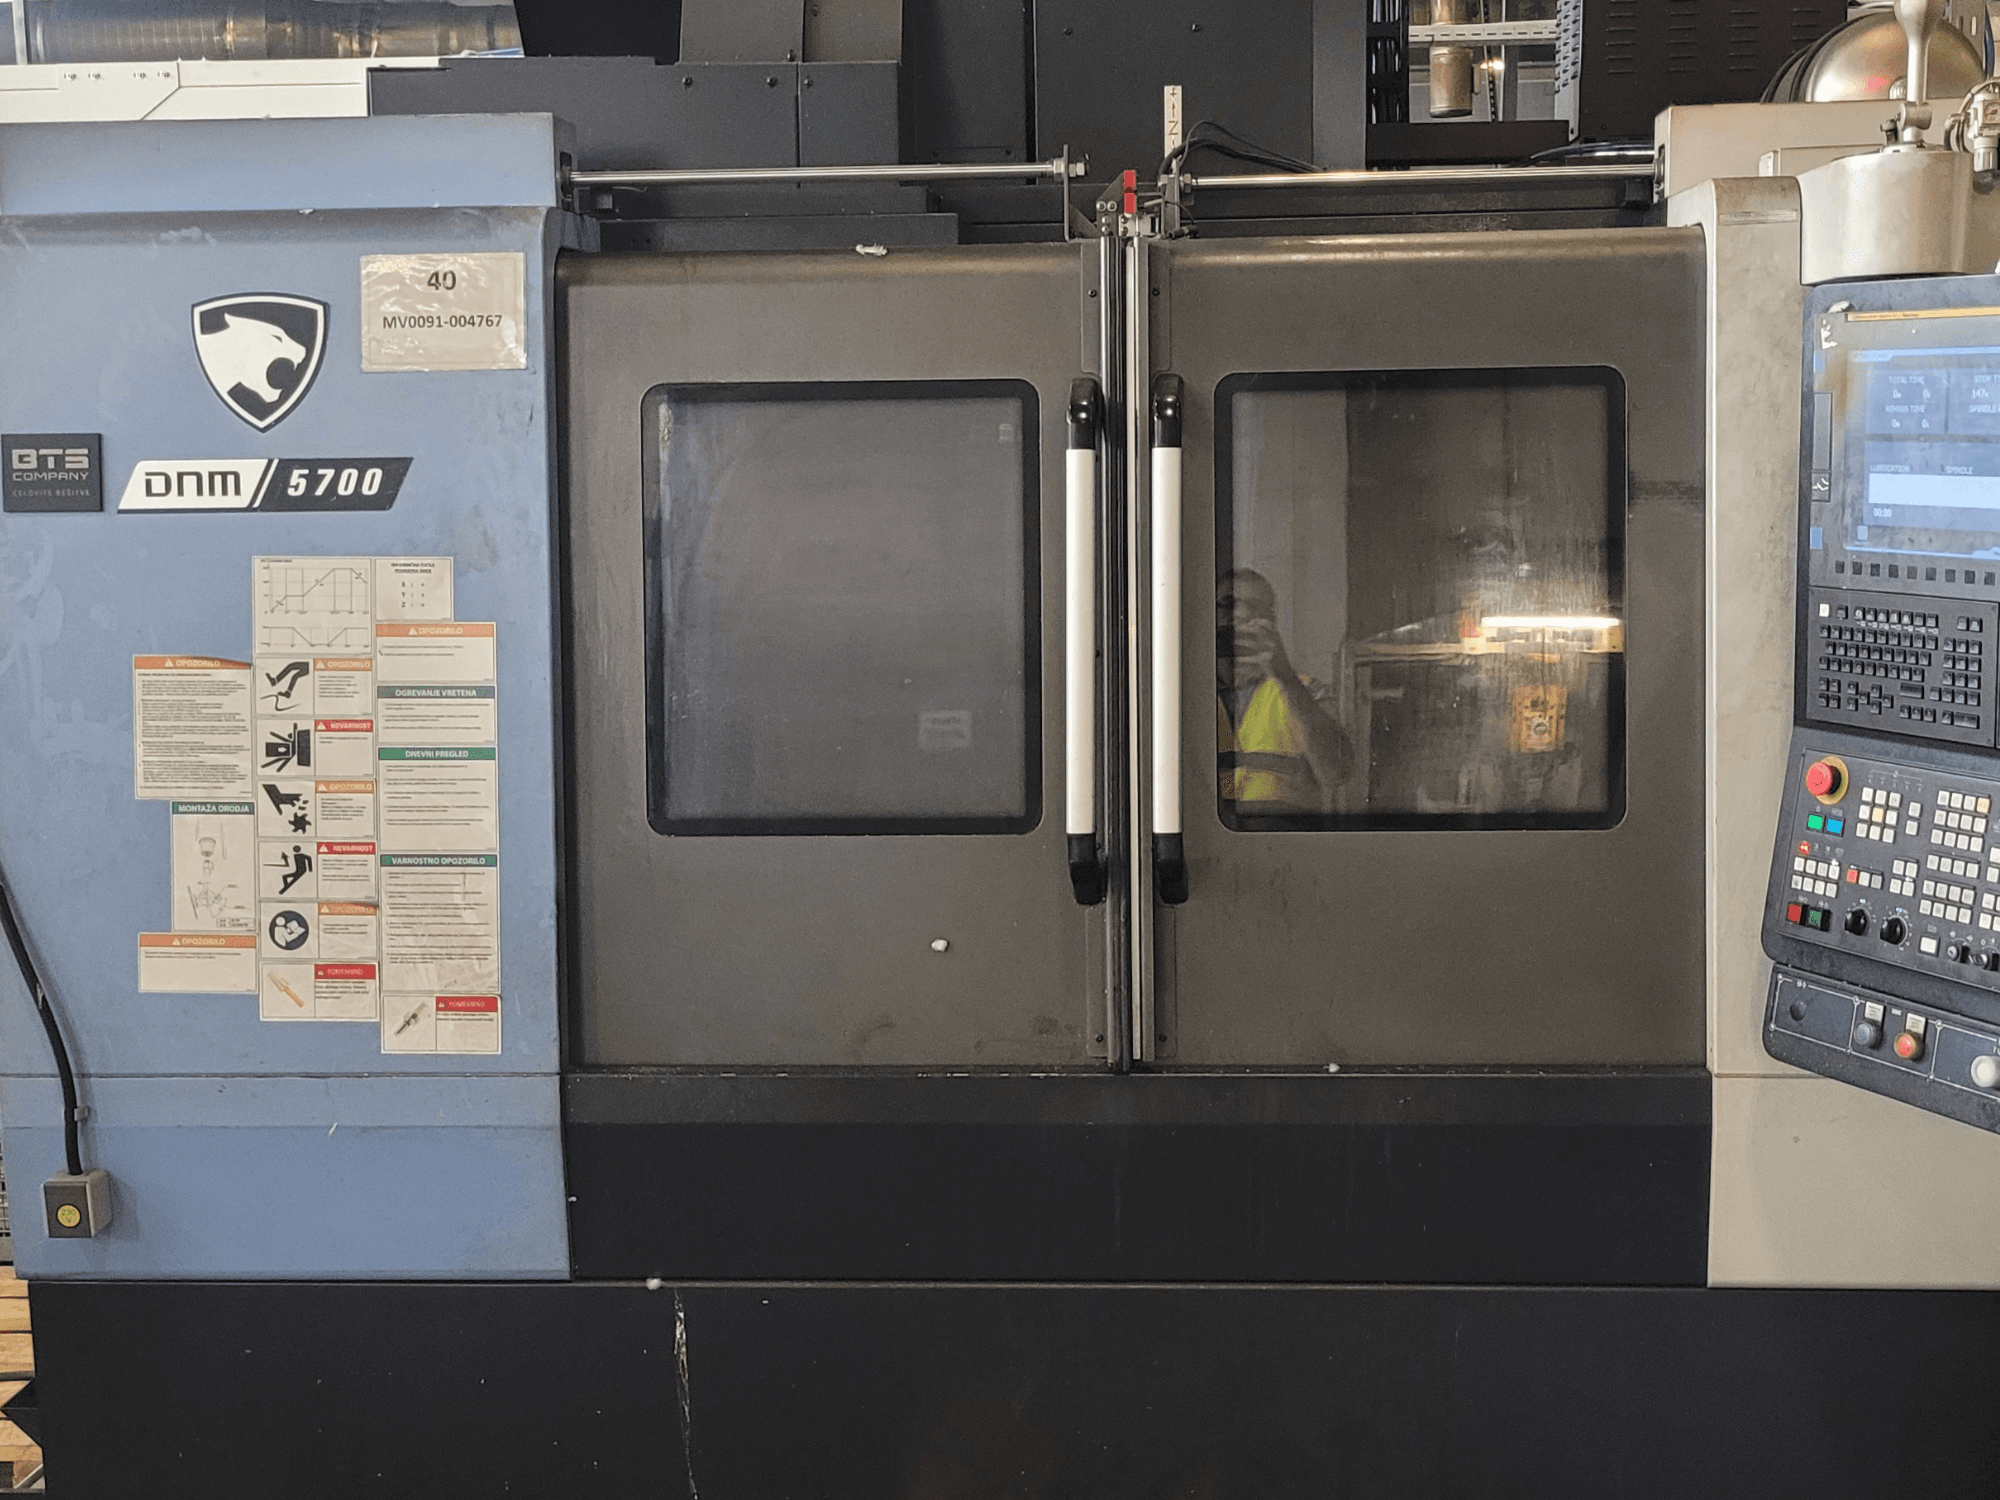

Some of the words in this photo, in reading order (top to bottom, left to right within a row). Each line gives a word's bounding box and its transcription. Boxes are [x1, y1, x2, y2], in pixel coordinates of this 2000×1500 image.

[427, 270, 457, 291] 40
[382, 314, 503, 329] MV0091-004767
[12, 448, 89, 469] BTS
[12, 472, 89, 481] COMPANY
[287, 468, 383, 496] 5700
[175, 659, 221, 667] OPOZORILO
[395, 689, 440, 697] OGREVANJE
[441, 689, 478, 697] VRETENA
[405, 750, 434, 758] DNEVNI
[435, 750, 469, 758] PREGLED
[329, 783, 373, 791] OPOZORILO
[178, 803, 217, 812] MONTAŽA
[218, 804, 250, 813] ORODJA
[333, 844, 374, 852] NEVARNOST
[391, 857, 440, 865] VARNOSTNO
[440, 857, 486, 865] OPOZORILO
[181, 937, 226, 946] OPOZORILO
